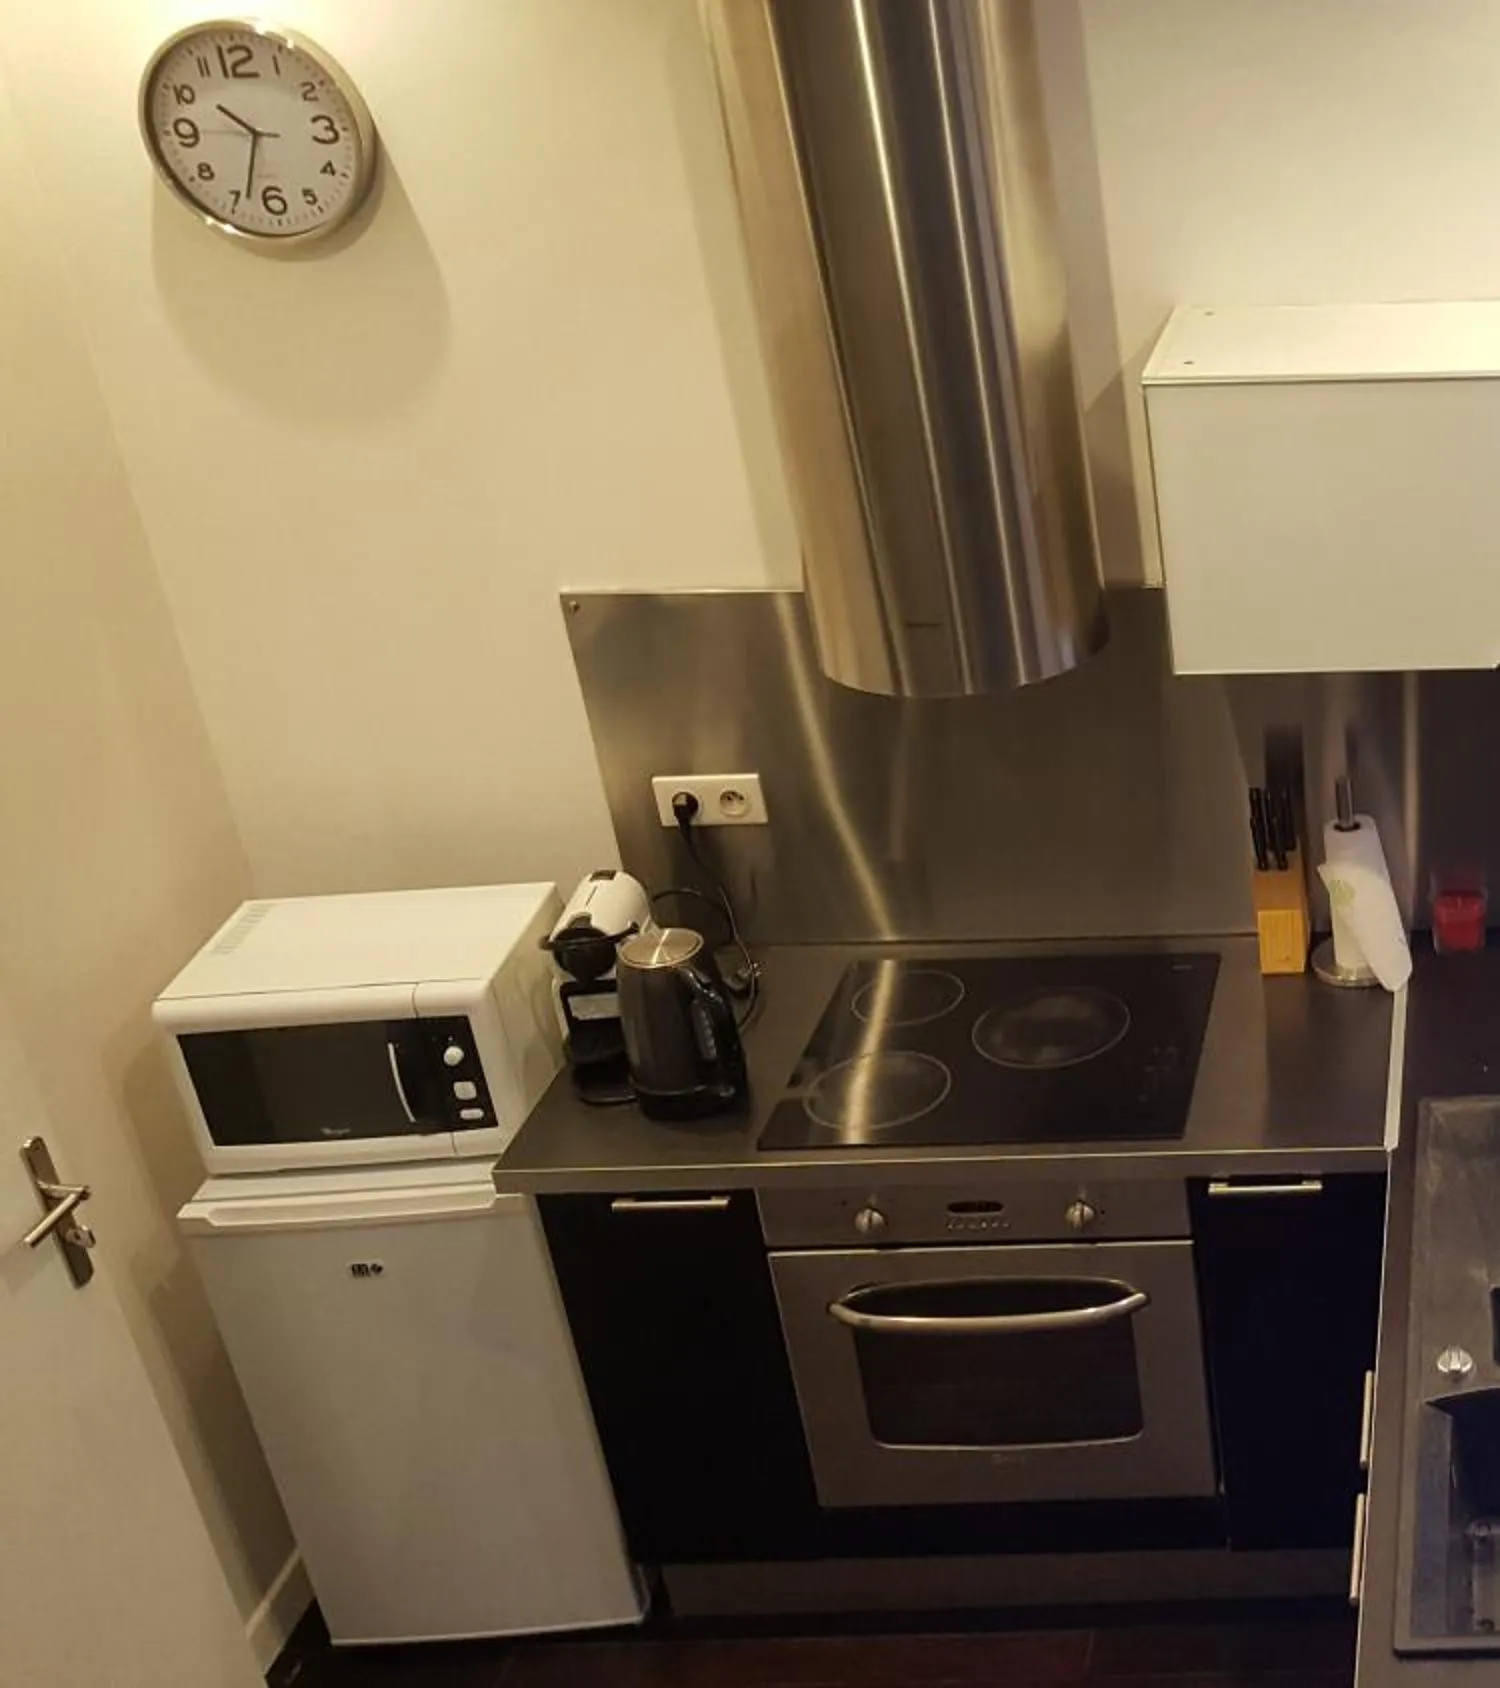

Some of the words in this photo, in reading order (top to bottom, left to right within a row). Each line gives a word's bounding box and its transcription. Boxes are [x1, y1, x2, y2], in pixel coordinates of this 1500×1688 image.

[197, 56, 211, 77] 11
[217, 44, 260, 79] 12
[271, 55, 281, 75] 1
[173, 84, 196, 105] 10
[300, 81, 319, 101] 2
[172, 117, 200, 148] 9
[311, 115, 340, 145] 3
[197, 162, 215, 181] 8
[319, 159, 336, 177] 4
[228, 190, 241, 213] 7
[261, 185, 288, 216] 6
[302, 188, 318, 206] 5
